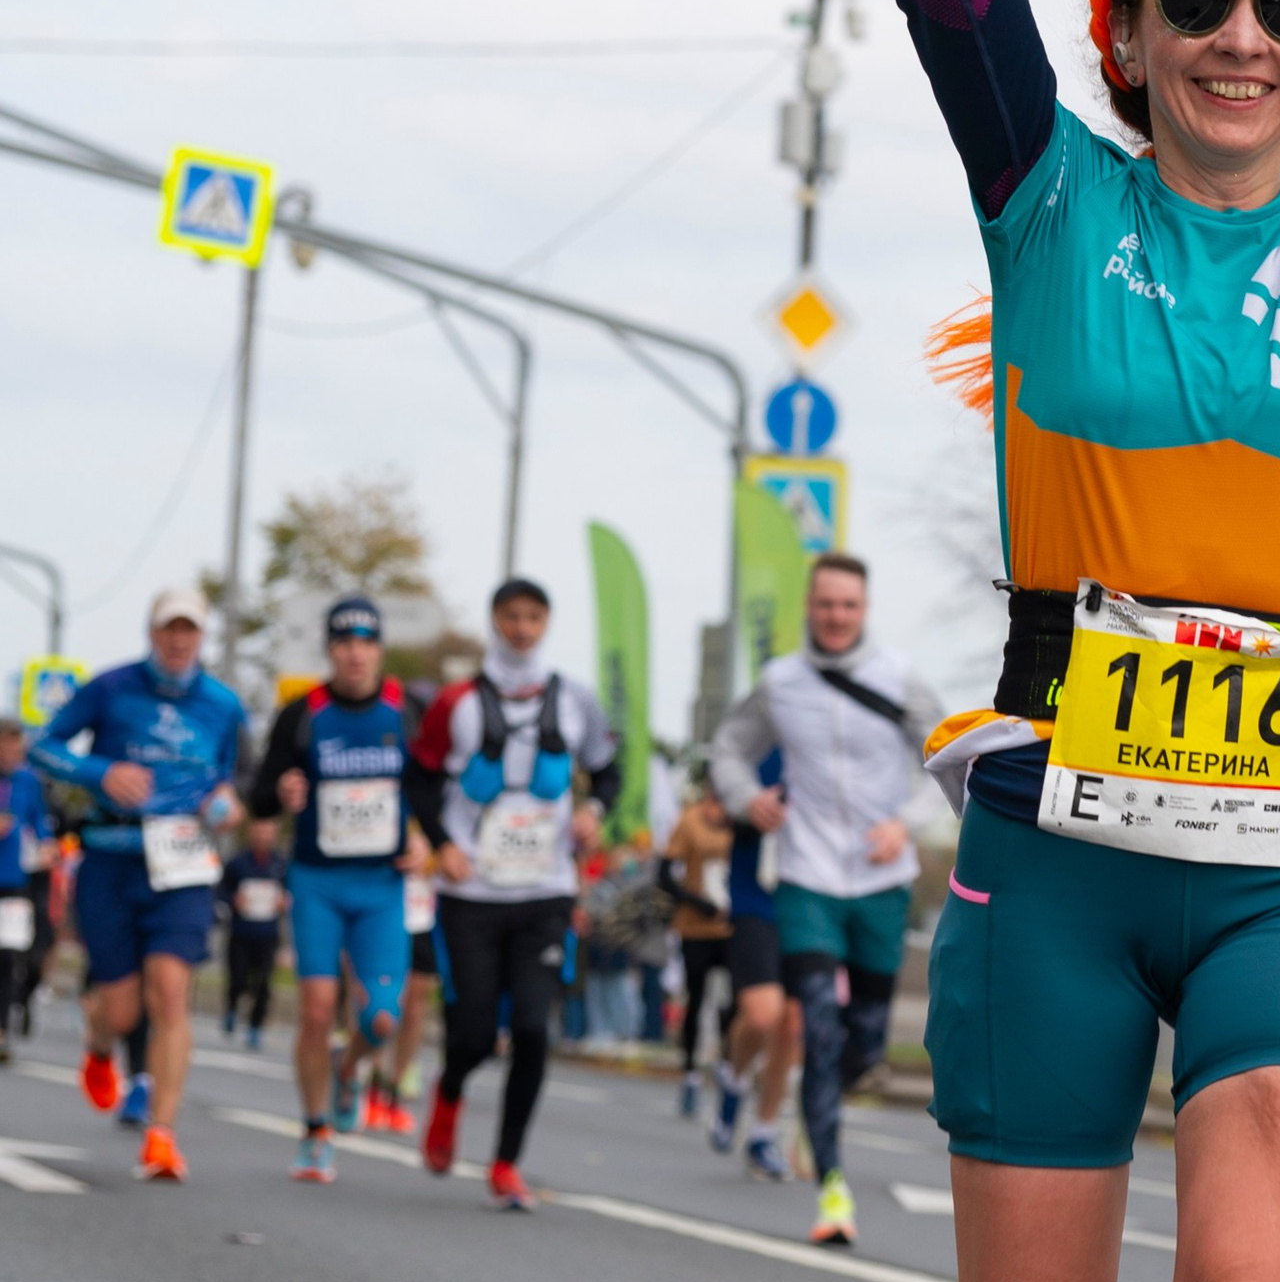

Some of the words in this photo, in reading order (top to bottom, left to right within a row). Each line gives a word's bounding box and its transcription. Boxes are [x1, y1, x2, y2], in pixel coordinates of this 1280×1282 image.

[1117, 743, 1270, 778] ЕКАТЕРИНА
[1070, 774, 1104, 821] E
[1175, 819, 1219, 832] FONBET
[1249, 825, 1279, 835] МАГНИТ
